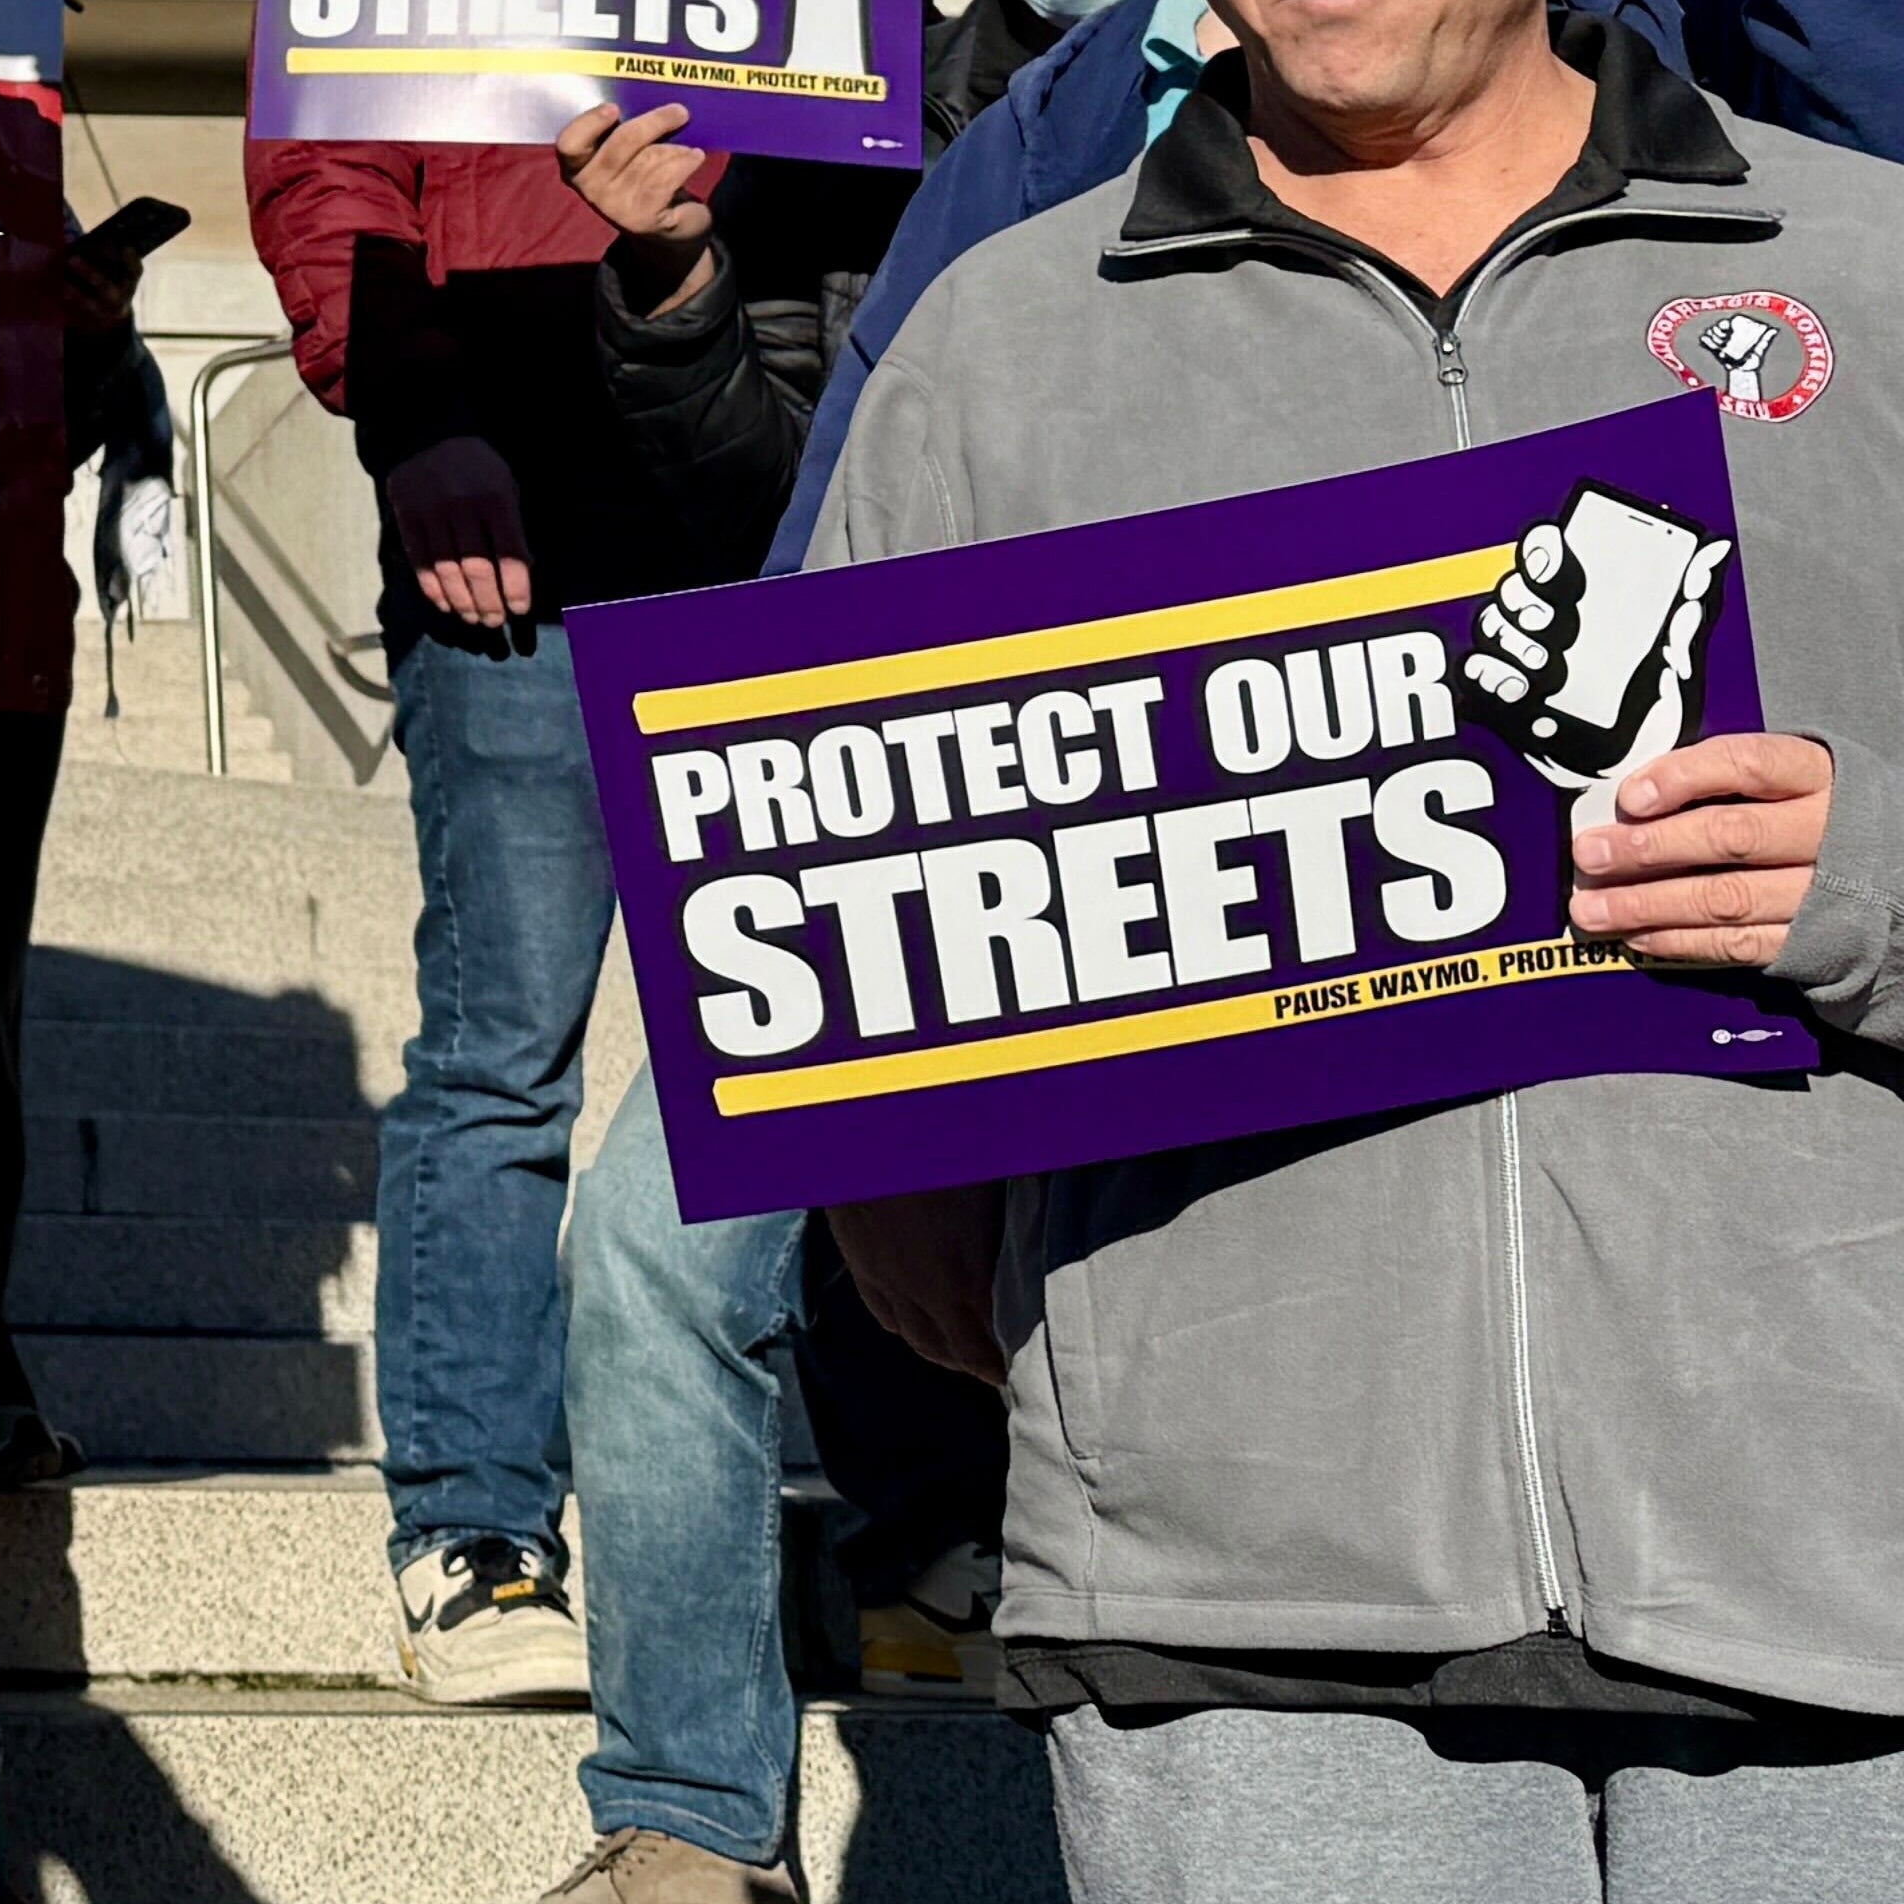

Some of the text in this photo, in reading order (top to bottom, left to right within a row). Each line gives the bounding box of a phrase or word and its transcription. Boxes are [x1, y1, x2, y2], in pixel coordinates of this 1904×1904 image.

[615, 57, 665, 77] PAUSE
[747, 70, 817, 90] PROTECT
[823, 76, 880, 95] PEOPLE
[651, 629, 1457, 863] PROTECT OUR
[680, 759, 1508, 1060] STREETS
[1274, 978, 1362, 1019] PAUSE
[1370, 958, 1490, 1000] WAYMO,
